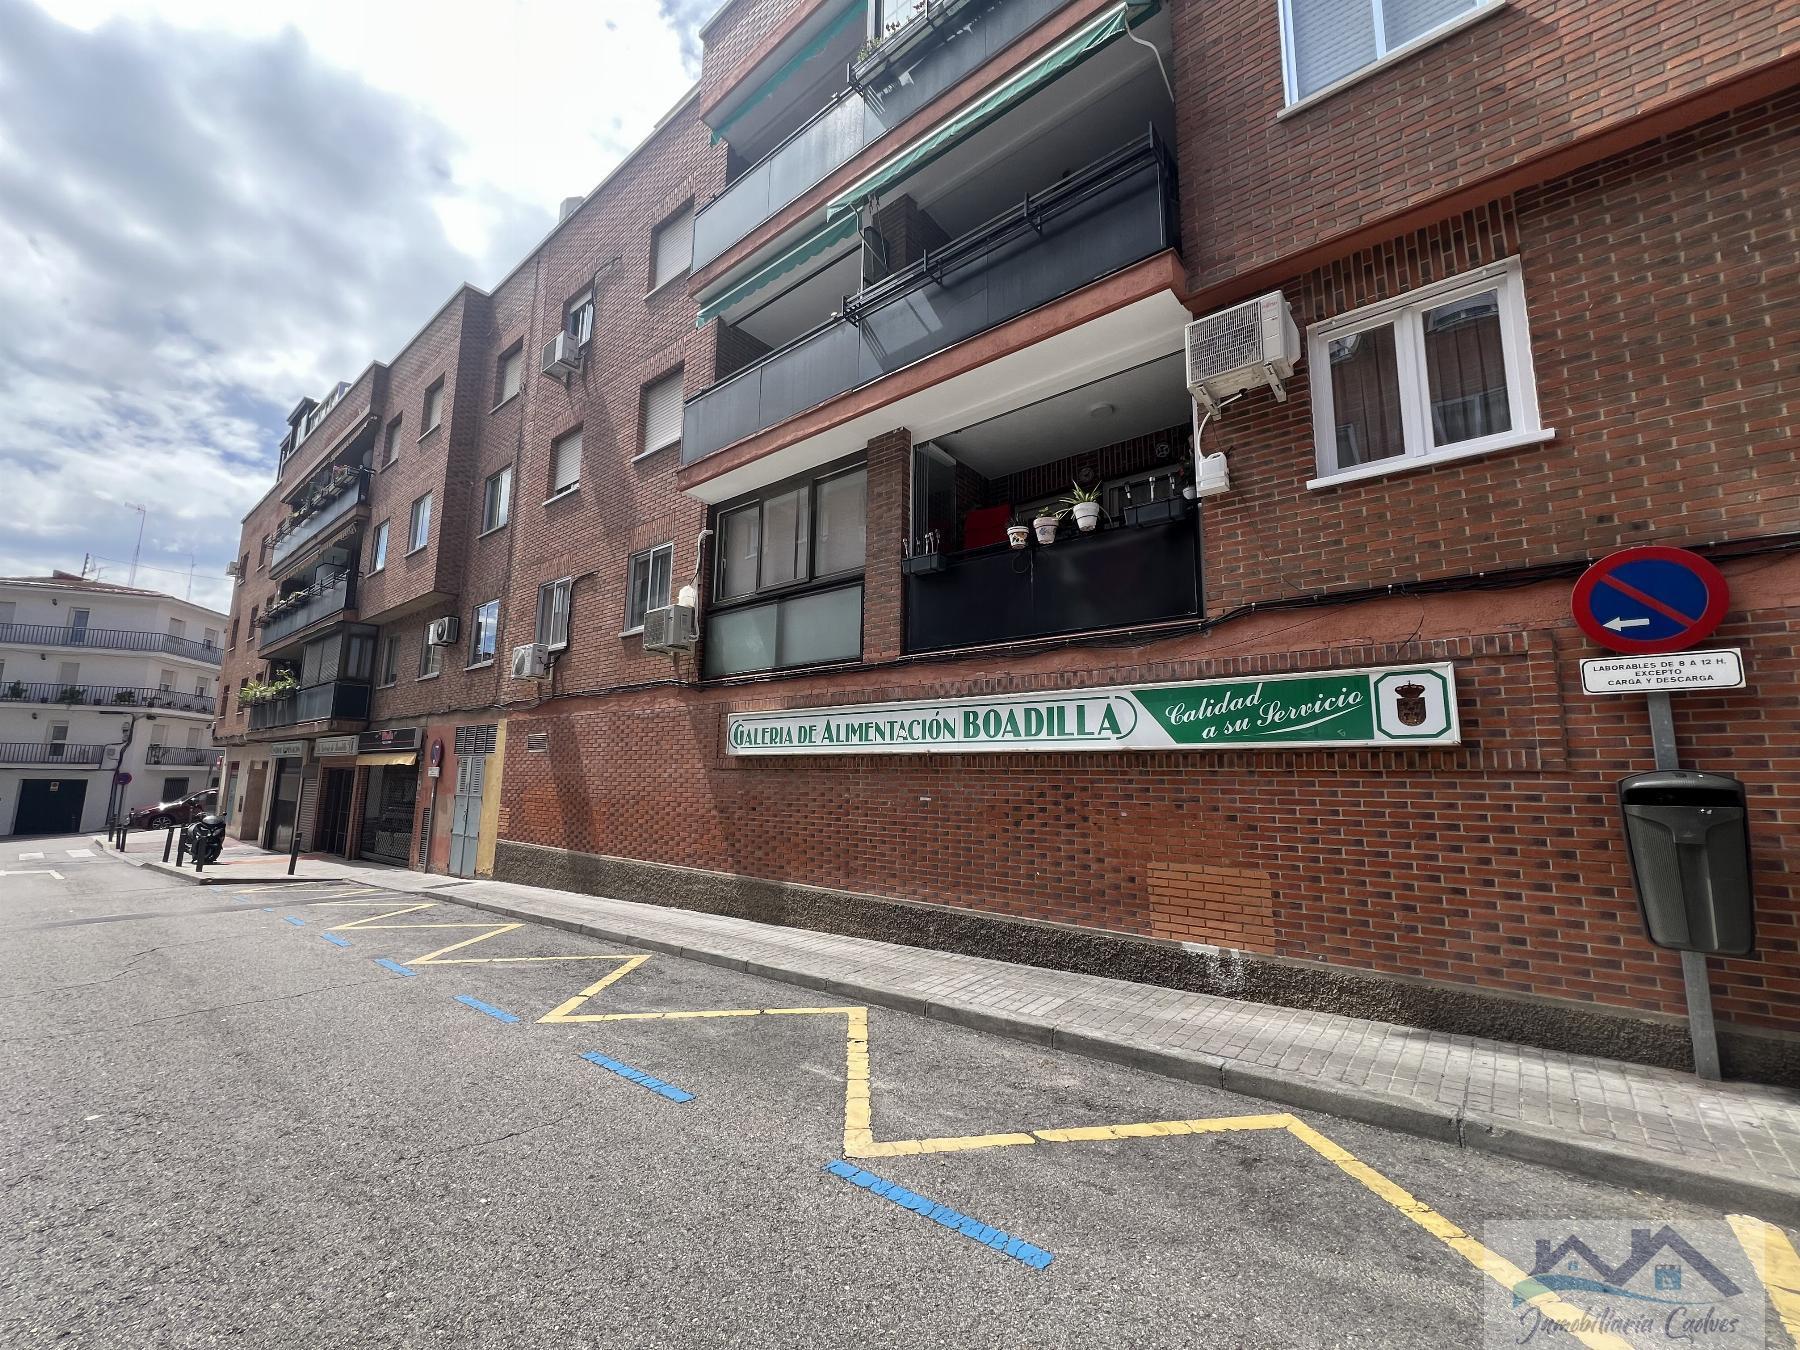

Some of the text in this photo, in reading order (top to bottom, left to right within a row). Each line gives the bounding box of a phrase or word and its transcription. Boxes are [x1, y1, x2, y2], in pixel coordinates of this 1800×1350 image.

[1593, 662, 1656, 672] LABORABLES
[1635, 669, 1682, 677] EXCEPTO
[1656, 674, 1714, 684] DESCARGA
[1166, 682, 1263, 725] Calidad
[1202, 687, 1363, 739] a su Servicio
[733, 703, 1122, 746] GALERIA DE ALIMENTACIÓN BOADILLA
